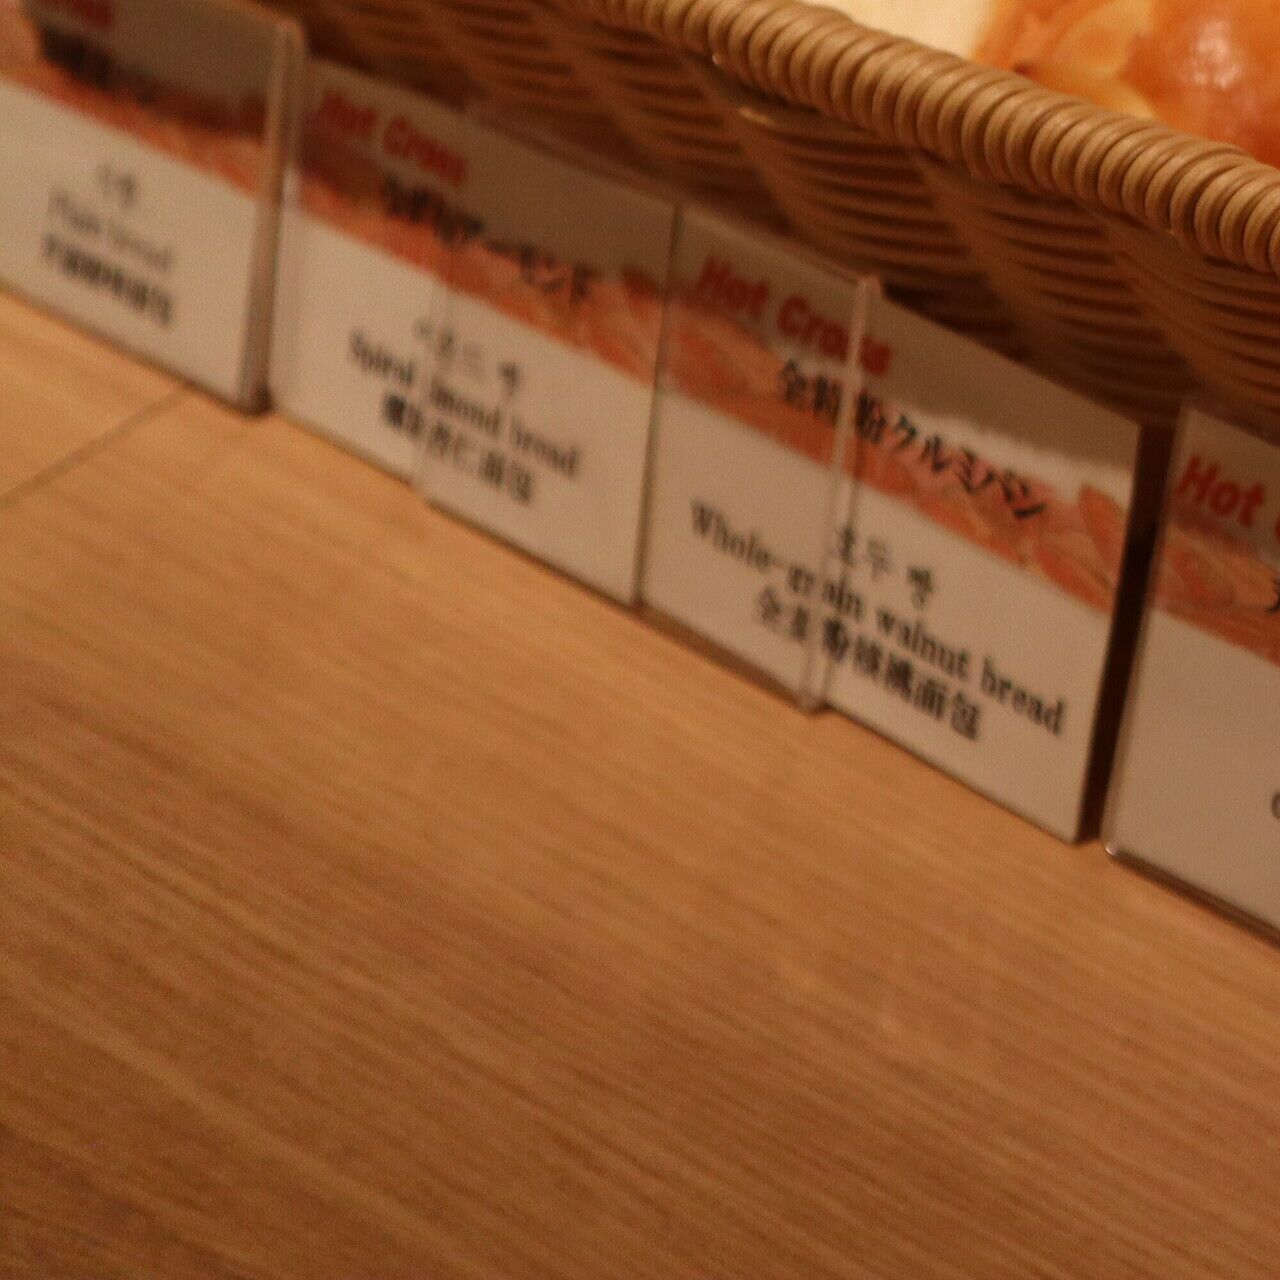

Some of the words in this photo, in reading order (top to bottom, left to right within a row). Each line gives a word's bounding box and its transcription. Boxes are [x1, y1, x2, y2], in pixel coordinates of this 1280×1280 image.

[699, 252, 768, 312] Hot
[1175, 453, 1264, 522] Hot
[875, 594, 974, 677] walnut
[981, 652, 1067, 738] bread
